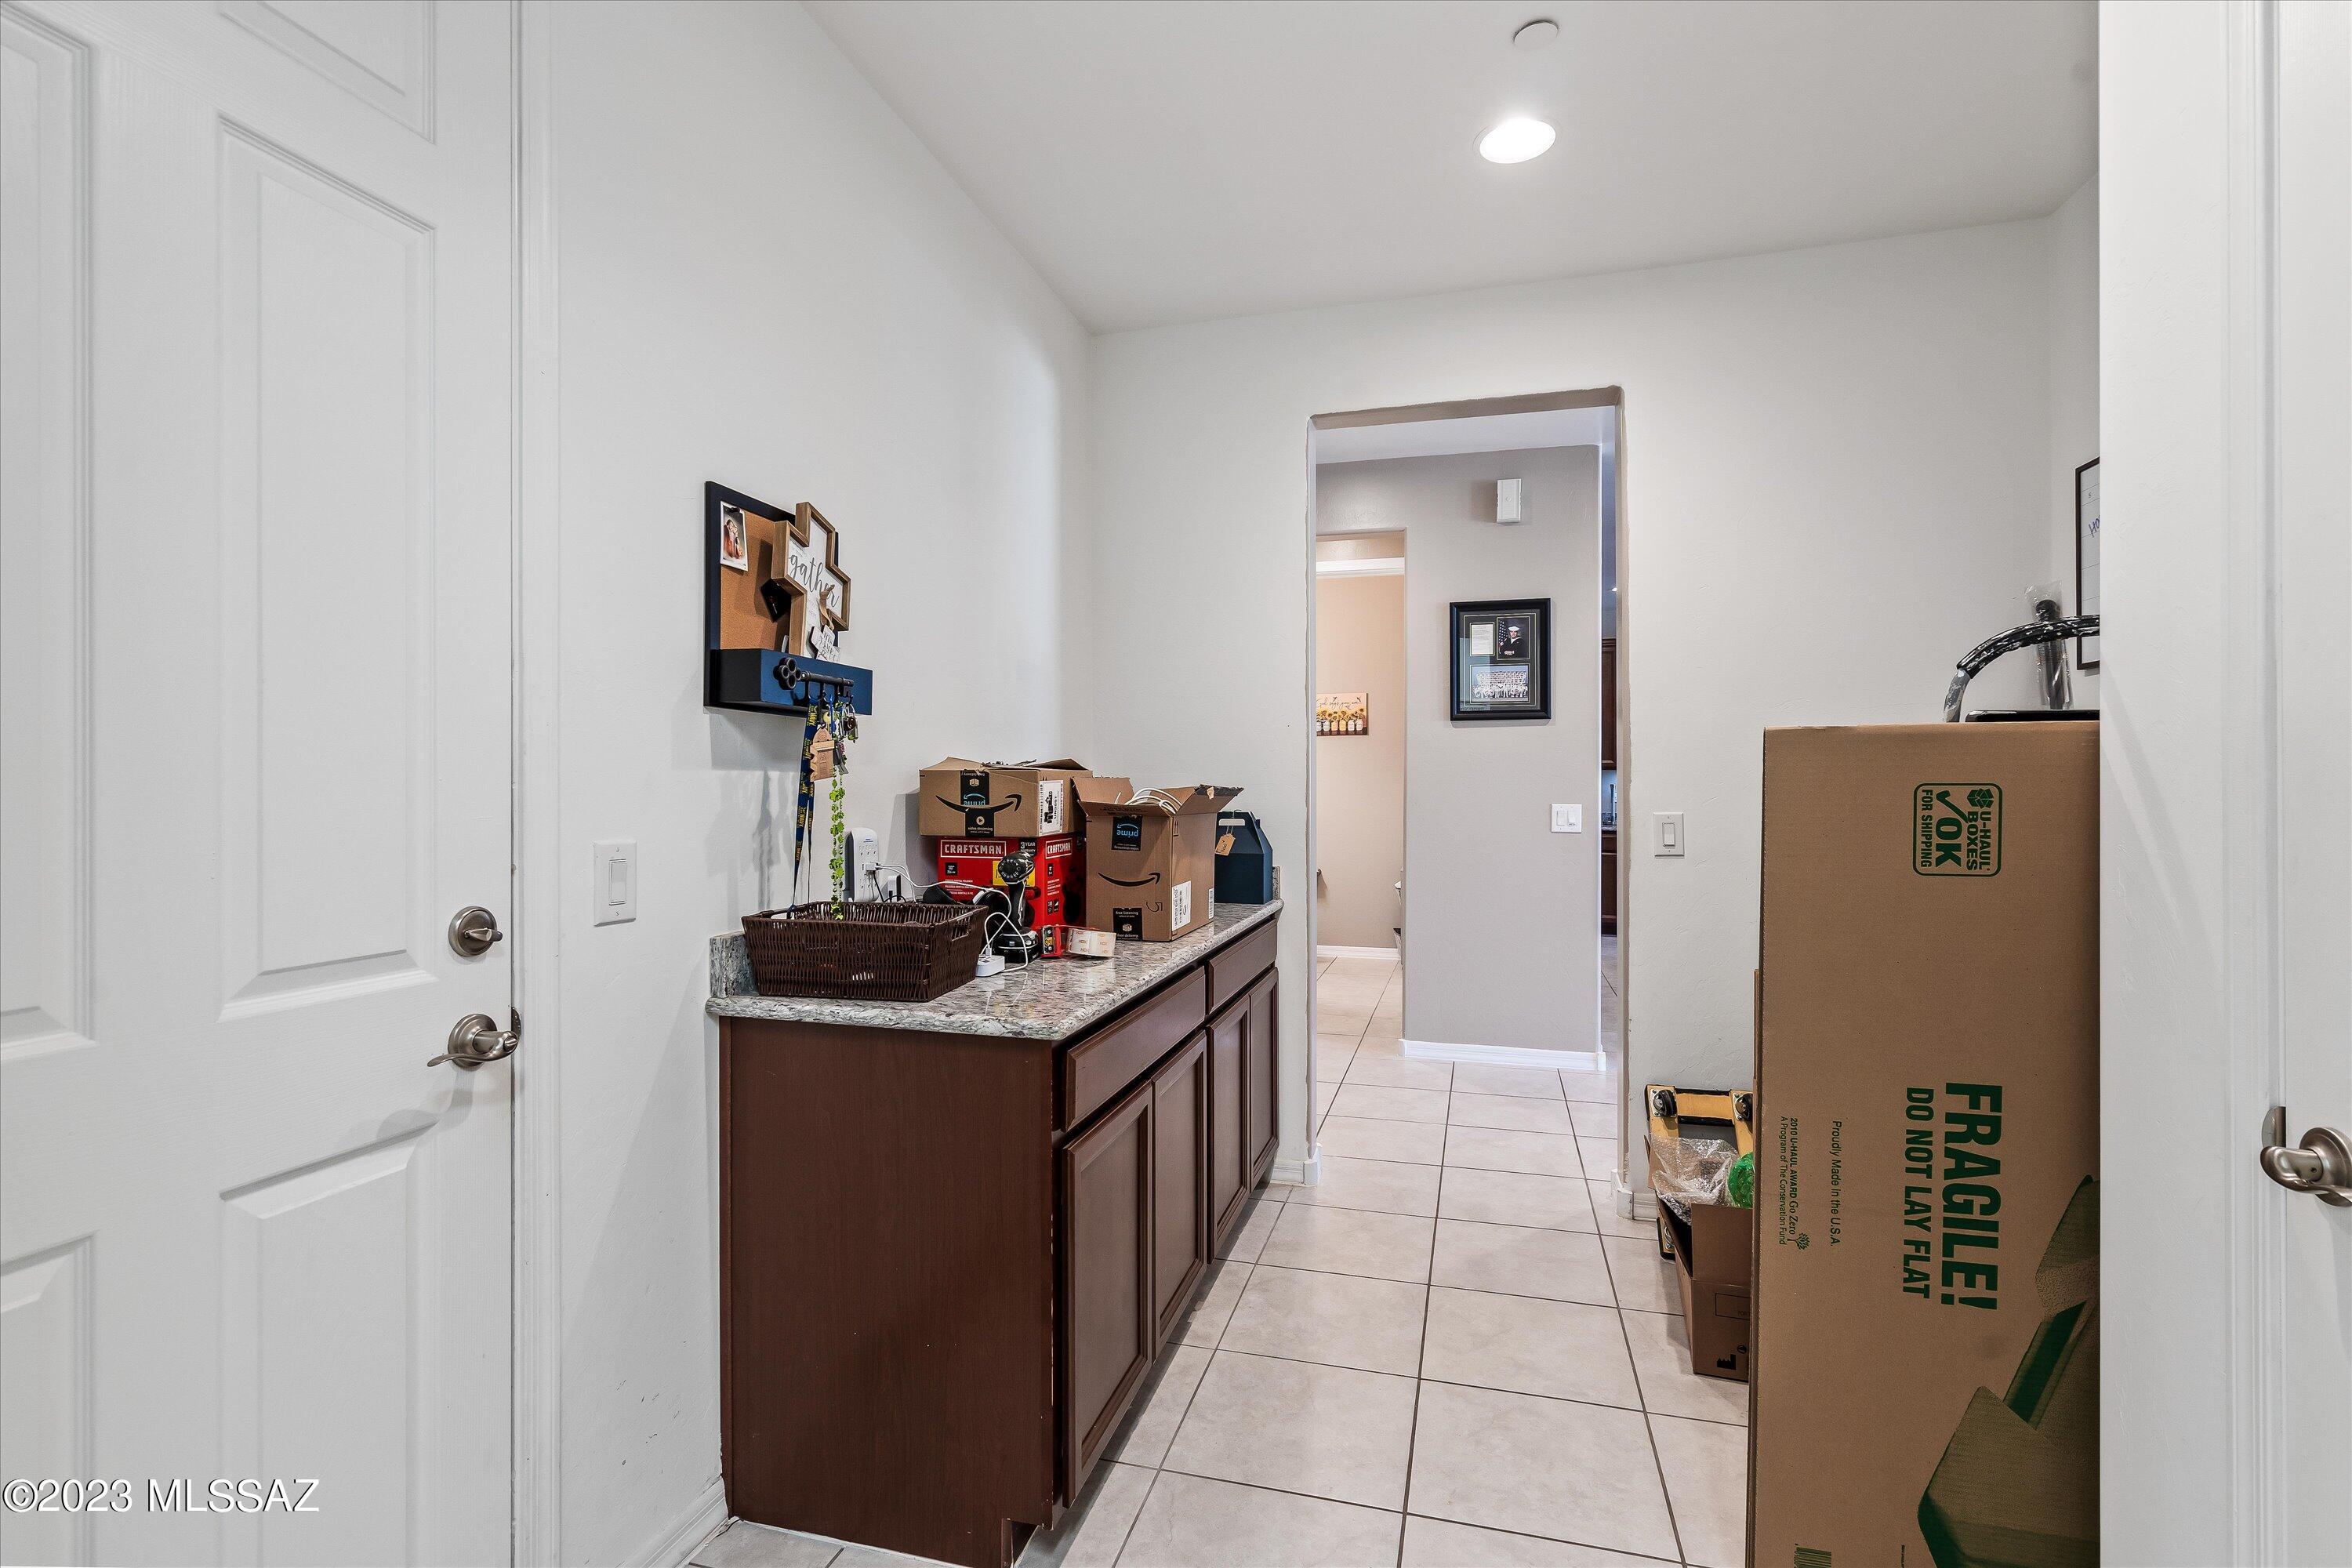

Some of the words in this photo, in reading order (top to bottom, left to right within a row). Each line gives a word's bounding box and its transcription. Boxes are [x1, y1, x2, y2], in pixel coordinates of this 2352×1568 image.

[1921, 789, 1933, 811] FOR
[1047, 842, 1071, 855] CRAFTSMAN
[1116, 829, 1139, 838] prime
[1921, 815, 1933, 868] SHIPPING
[1935, 817, 1962, 868] OK
[1966, 811, 1979, 871] BOXES
[1979, 811, 1991, 870] U-HAUL
[944, 843, 1004, 855] CRAFTSMAN
[1905, 1087, 1935, 1122] DO
[1778, 1123, 1788, 1153] Program
[1829, 1120, 1842, 1156] Proudly
[1904, 1129, 1934, 1180] NOT
[1780, 1163, 1788, 1178] The
[1789, 1169, 1798, 1199] AWARD
[1831, 1159, 1842, 1185] Made
[1779, 1179, 1788, 1225] Conservation
[1789, 1200, 1798, 1214] Go
[1831, 1200, 1841, 1214] the
[1904, 1185, 1933, 1233] LAY
[1940, 1082, 2003, 1311] FRAGILE!
[1779, 1227, 1788, 1245] Fund
[1788, 1215, 1798, 1235] Zero
[1830, 1217, 1841, 1247] U.S.A.
[1903, 1239, 1931, 1299] FLAT
